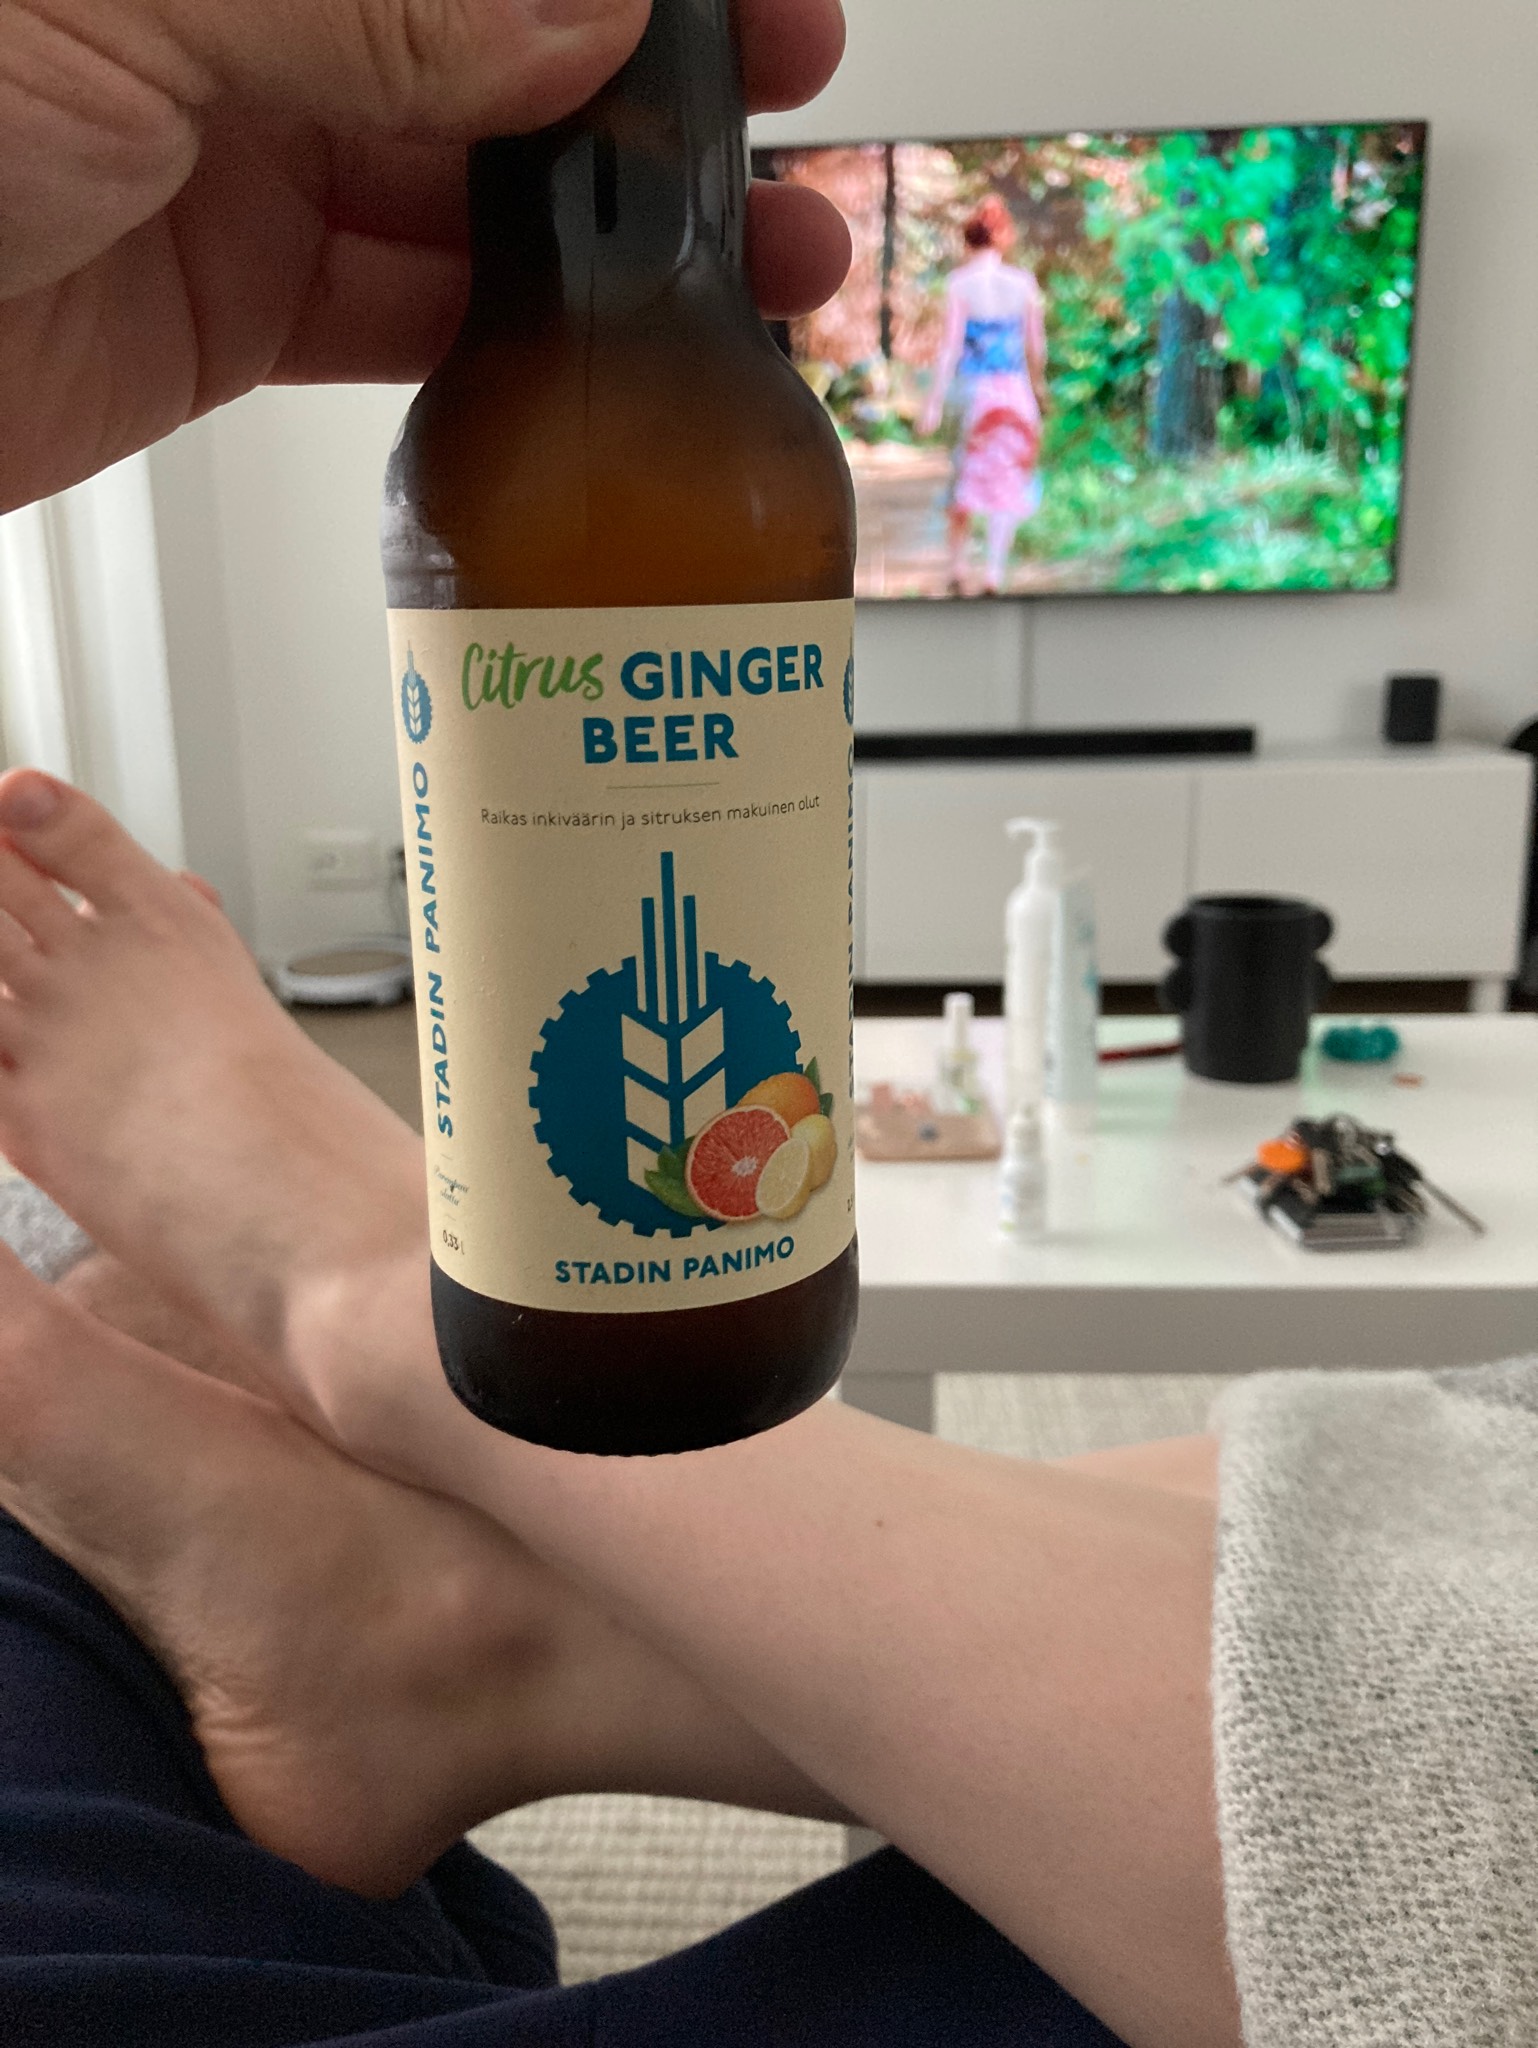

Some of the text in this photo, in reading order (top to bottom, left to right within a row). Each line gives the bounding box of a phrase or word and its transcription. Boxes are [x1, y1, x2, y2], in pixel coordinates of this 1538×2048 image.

[461, 641, 824, 711] Citrus GINGER
[582, 712, 739, 764] BEER
[481, 794, 820, 831] Raikas inkiväärin ja sitruksen makuinen olut
[412, 761, 441, 955] PANIMO
[427, 971, 454, 1138] STADIN
[555, 1236, 795, 1285] STADIN PANIMO
